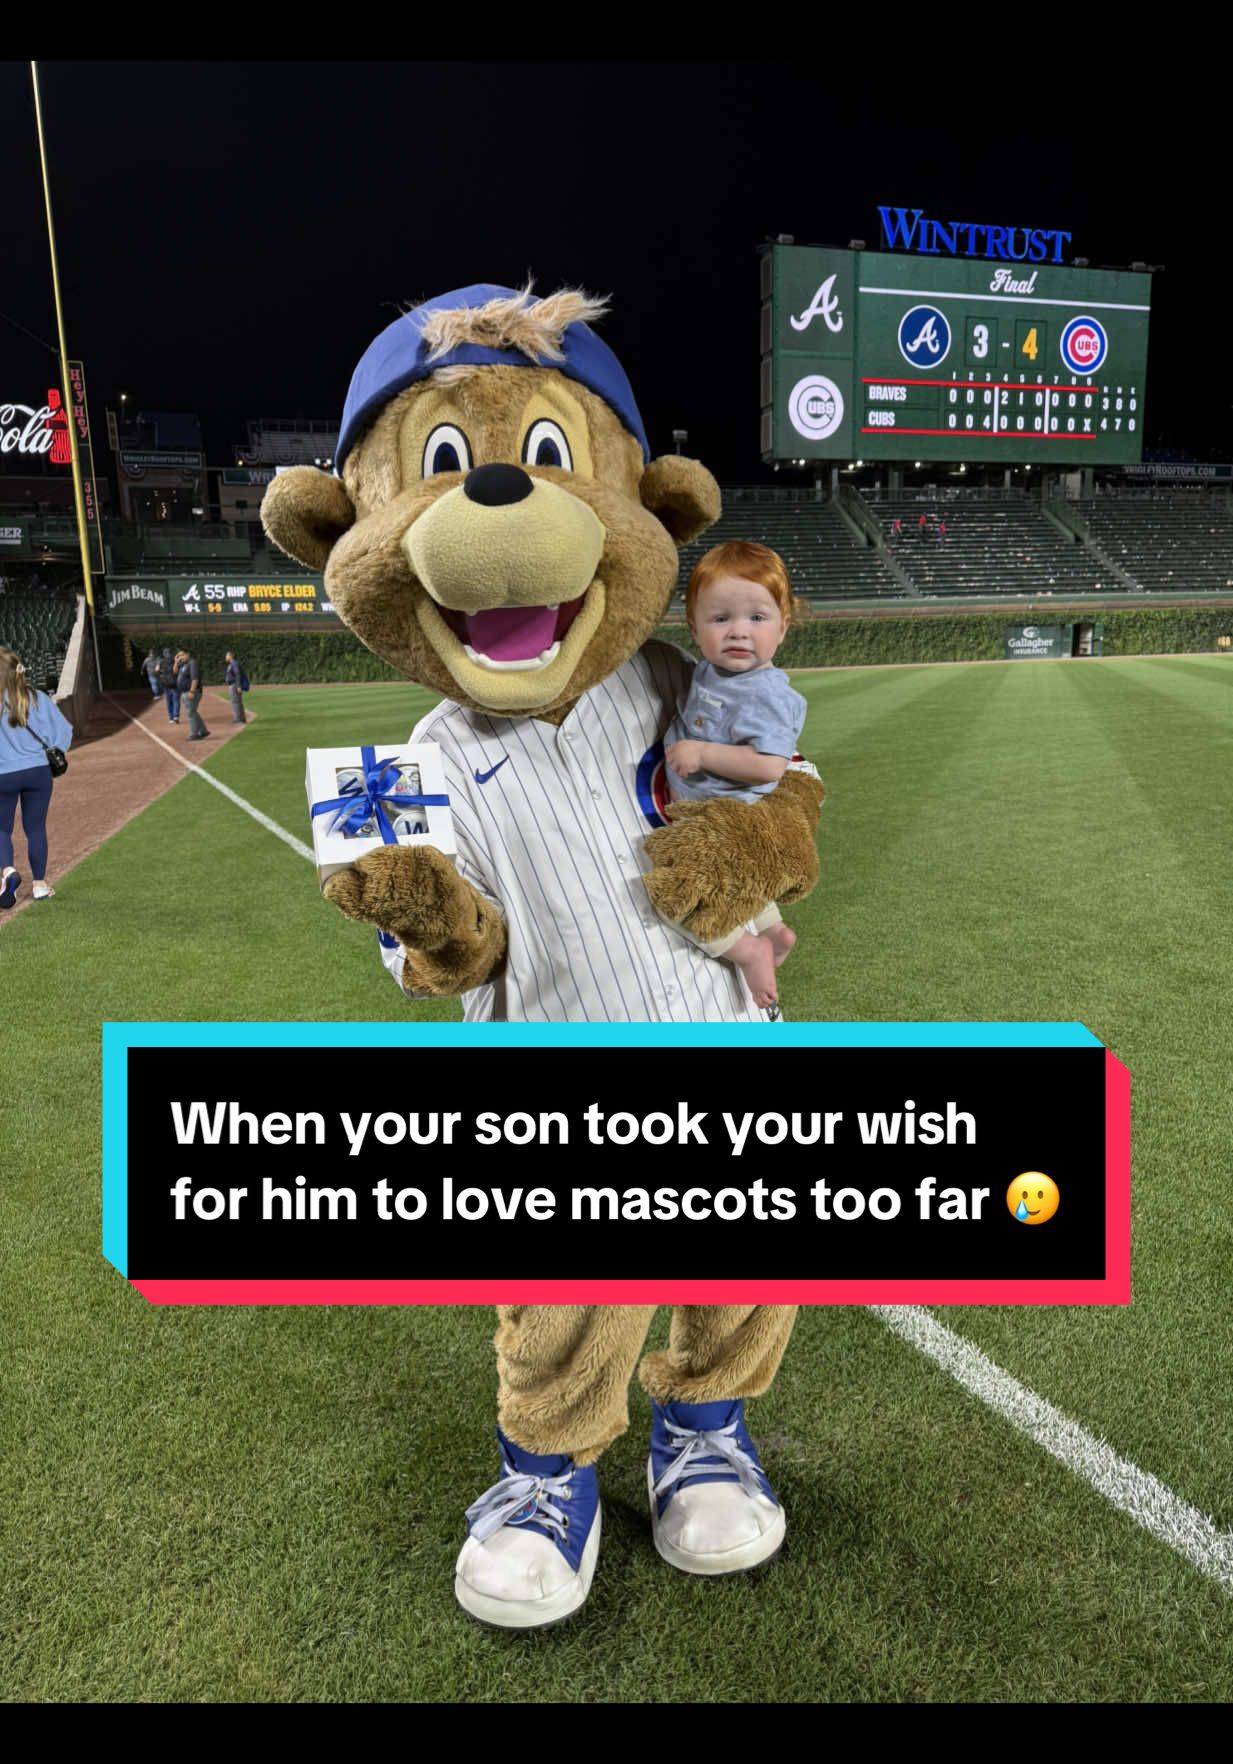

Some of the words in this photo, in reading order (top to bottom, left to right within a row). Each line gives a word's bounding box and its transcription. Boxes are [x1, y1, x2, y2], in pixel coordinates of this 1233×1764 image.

[878, 206, 1072, 264] WINTRUST
[989, 269, 1038, 294] Final
[972, 324, 989, 358] 3
[1022, 328, 1038, 360] 4
[868, 386, 908, 401] BRAVES
[949, 388, 957, 403] 0
[966, 389, 975, 404] 0
[983, 389, 992, 404] 0
[1001, 390, 1009, 405] 2
[1019, 391, 1024, 405] 1
[1035, 391, 1043, 406] 0
[1051, 392, 1060, 407] 0
[1068, 393, 1076, 408] 0
[1084, 393, 1093, 408] 0
[1102, 397, 1110, 410] 3
[1129, 398, 1137, 411] 0
[868, 411, 896, 426] CUBS
[948, 413, 957, 428] 0
[965, 414, 974, 429] 0
[982, 415, 991, 429] 4
[1000, 415, 1008, 430] 0
[1067, 417, 1075, 432] 0
[1083, 418, 1091, 432] X
[1100, 418, 1108, 431] 4
[1115, 418, 1122, 431] 7
[84, 482, 94, 520] 355
[131, 584, 165, 608] BEAM
[205, 584, 225, 599] 55
[249, 585, 281, 597] BRYCE
[283, 585, 315, 597] ELDER
[1008, 638, 1054, 648] Gallagher
